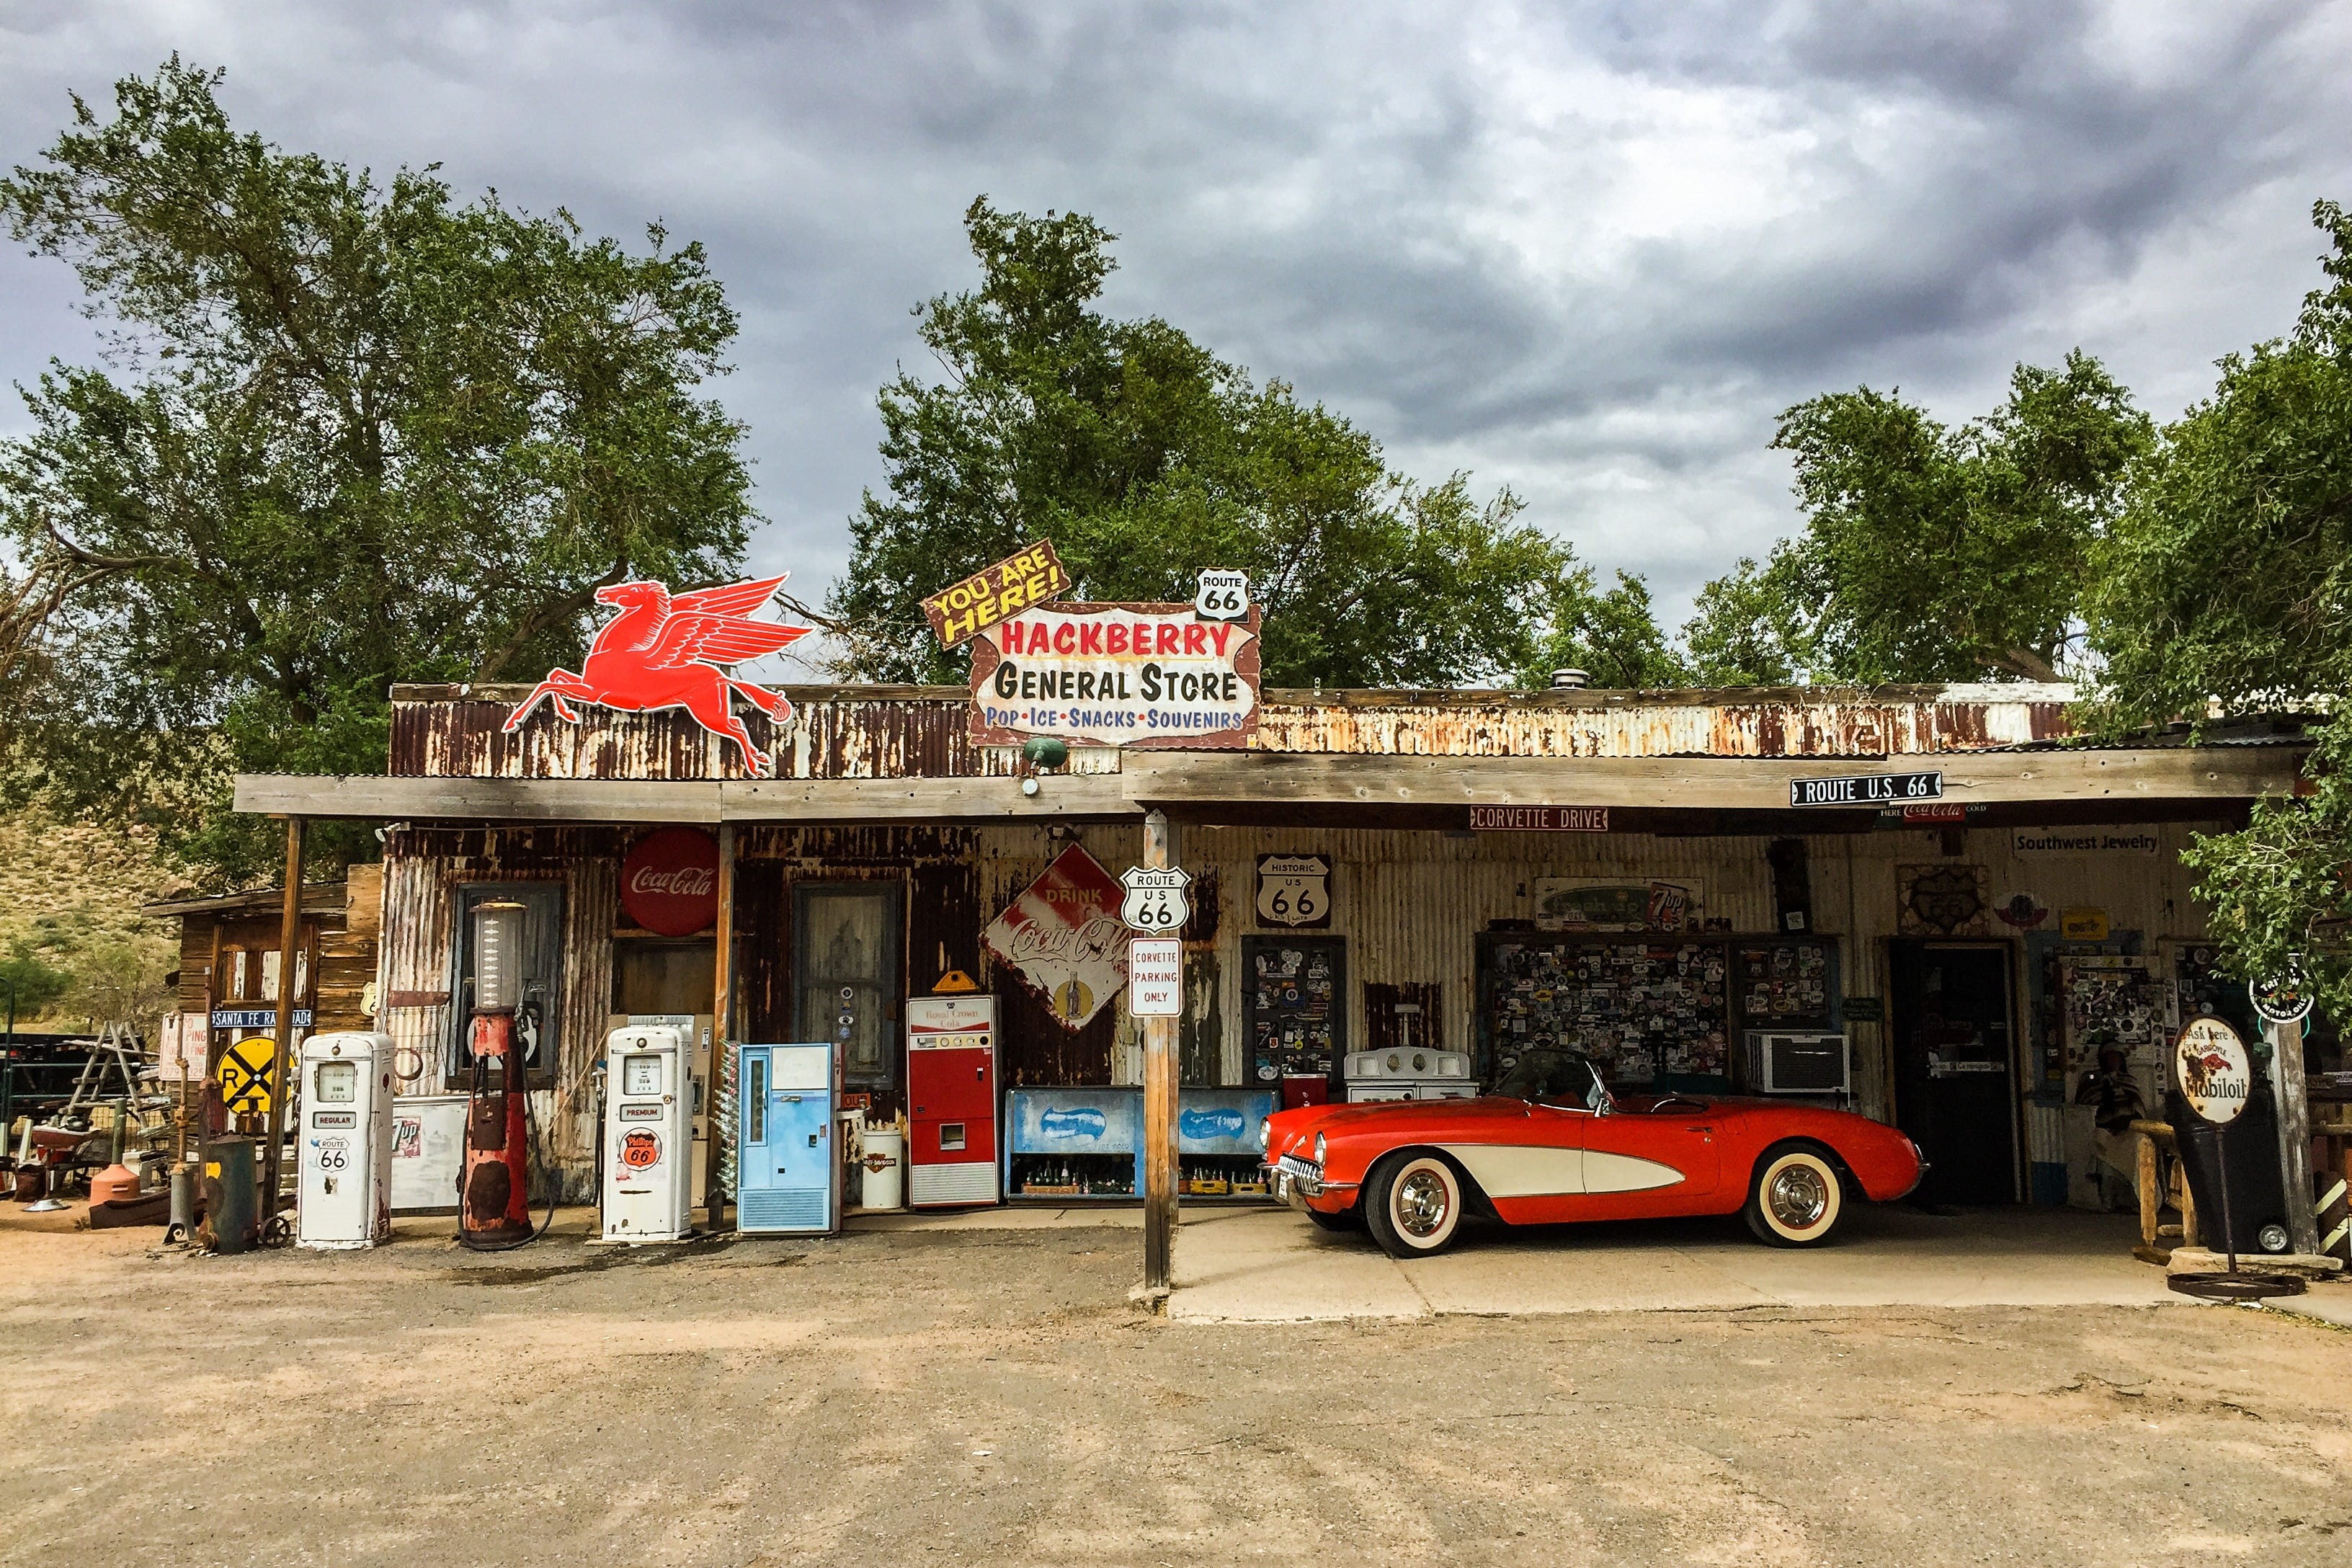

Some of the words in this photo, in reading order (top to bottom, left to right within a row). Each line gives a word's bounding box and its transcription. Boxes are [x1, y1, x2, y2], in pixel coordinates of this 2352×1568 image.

[933, 576, 990, 617] YOU
[1002, 548, 1050, 587] ARE
[1203, 576, 1242, 588] ROUTE
[943, 566, 1059, 643] HERE!
[1204, 590, 1240, 610] 66
[1002, 620, 1231, 657] HACKBERRY
[994, 660, 1131, 700] GENERAL
[1141, 662, 1237, 701] STORE
[1069, 707, 1136, 729] SNACKS
[1147, 708, 1243, 729] SOUVENIRS
[1805, 780, 1856, 802] ROUTE
[1867, 778, 1898, 799] U.S.
[1907, 775, 1928, 796] 66
[1476, 808, 1549, 828] CORVETTE
[1560, 809, 1602, 829] DRIVE
[2017, 835, 2098, 850] Southwest
[2101, 834, 2158, 853] Jewelry
[631, 865, 716, 896] Coca-Cola
[1137, 876, 1175, 886] ROUTE
[1045, 888, 1104, 904] DRINK
[1271, 888, 1314, 915] 66
[1138, 903, 1172, 925] 66
[1136, 952, 1177, 963] CORVETTE
[1134, 972, 1177, 983] PARKING
[1144, 992, 1168, 1002] ONLY
[215, 1012, 243, 1025] SANTA
[249, 1012, 259, 1025] FE
[264, 1012, 307, 1025] RAAD
[926, 1010, 949, 1020] Royal
[952, 1009, 978, 1018] Crown
[940, 1019, 960, 1028] Cola
[2188, 1026, 2205, 1040] Ask
[2196, 1044, 2227, 1056] GARGOYLE
[223, 1068, 239, 1088] R
[2184, 1077, 2247, 1099] Mobiloil
[627, 1136, 653, 1148] Phillips
[321, 1150, 345, 1168] 66
[631, 1149, 650, 1162] 66
